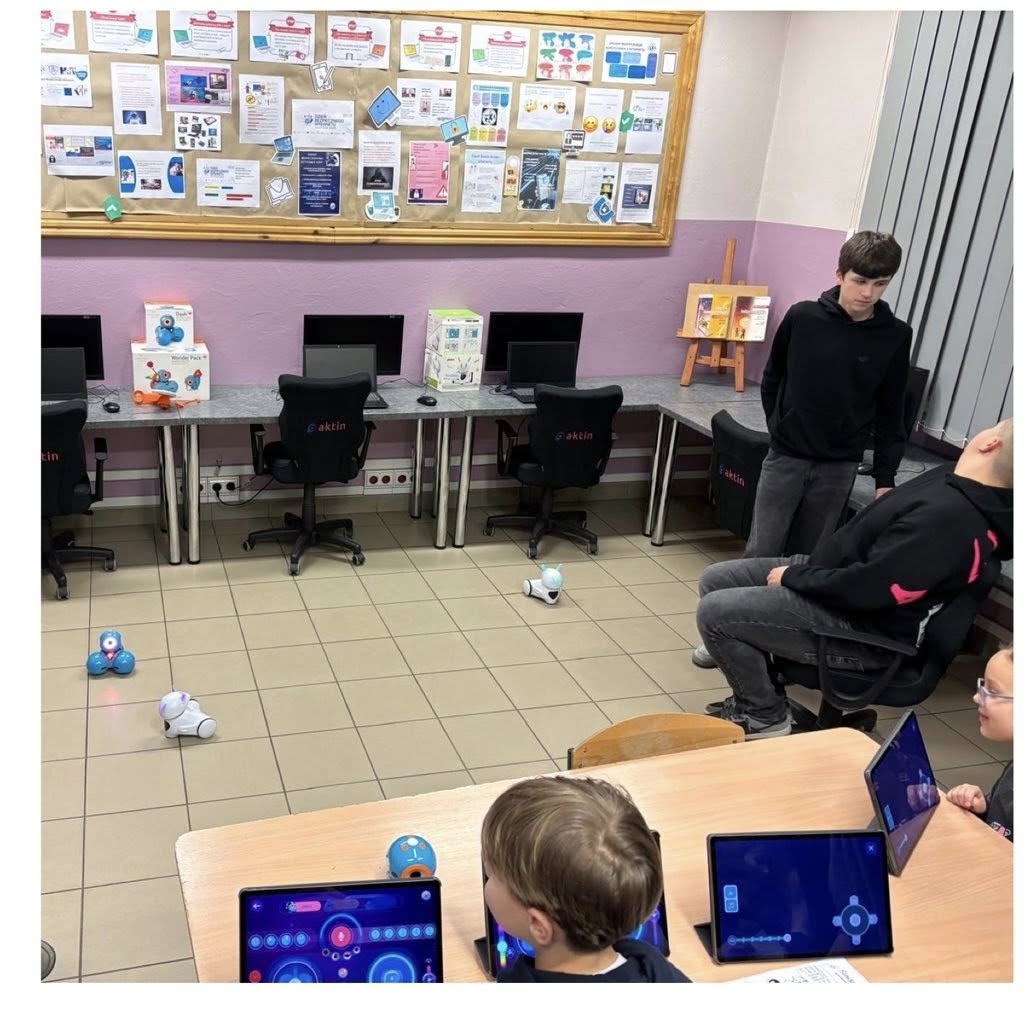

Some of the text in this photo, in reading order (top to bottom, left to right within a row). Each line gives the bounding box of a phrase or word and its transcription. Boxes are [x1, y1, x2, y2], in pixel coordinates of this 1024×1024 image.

[318, 421, 346, 432] aktin
[566, 431, 593, 441] aktin
[724, 468, 745, 487] aktin
